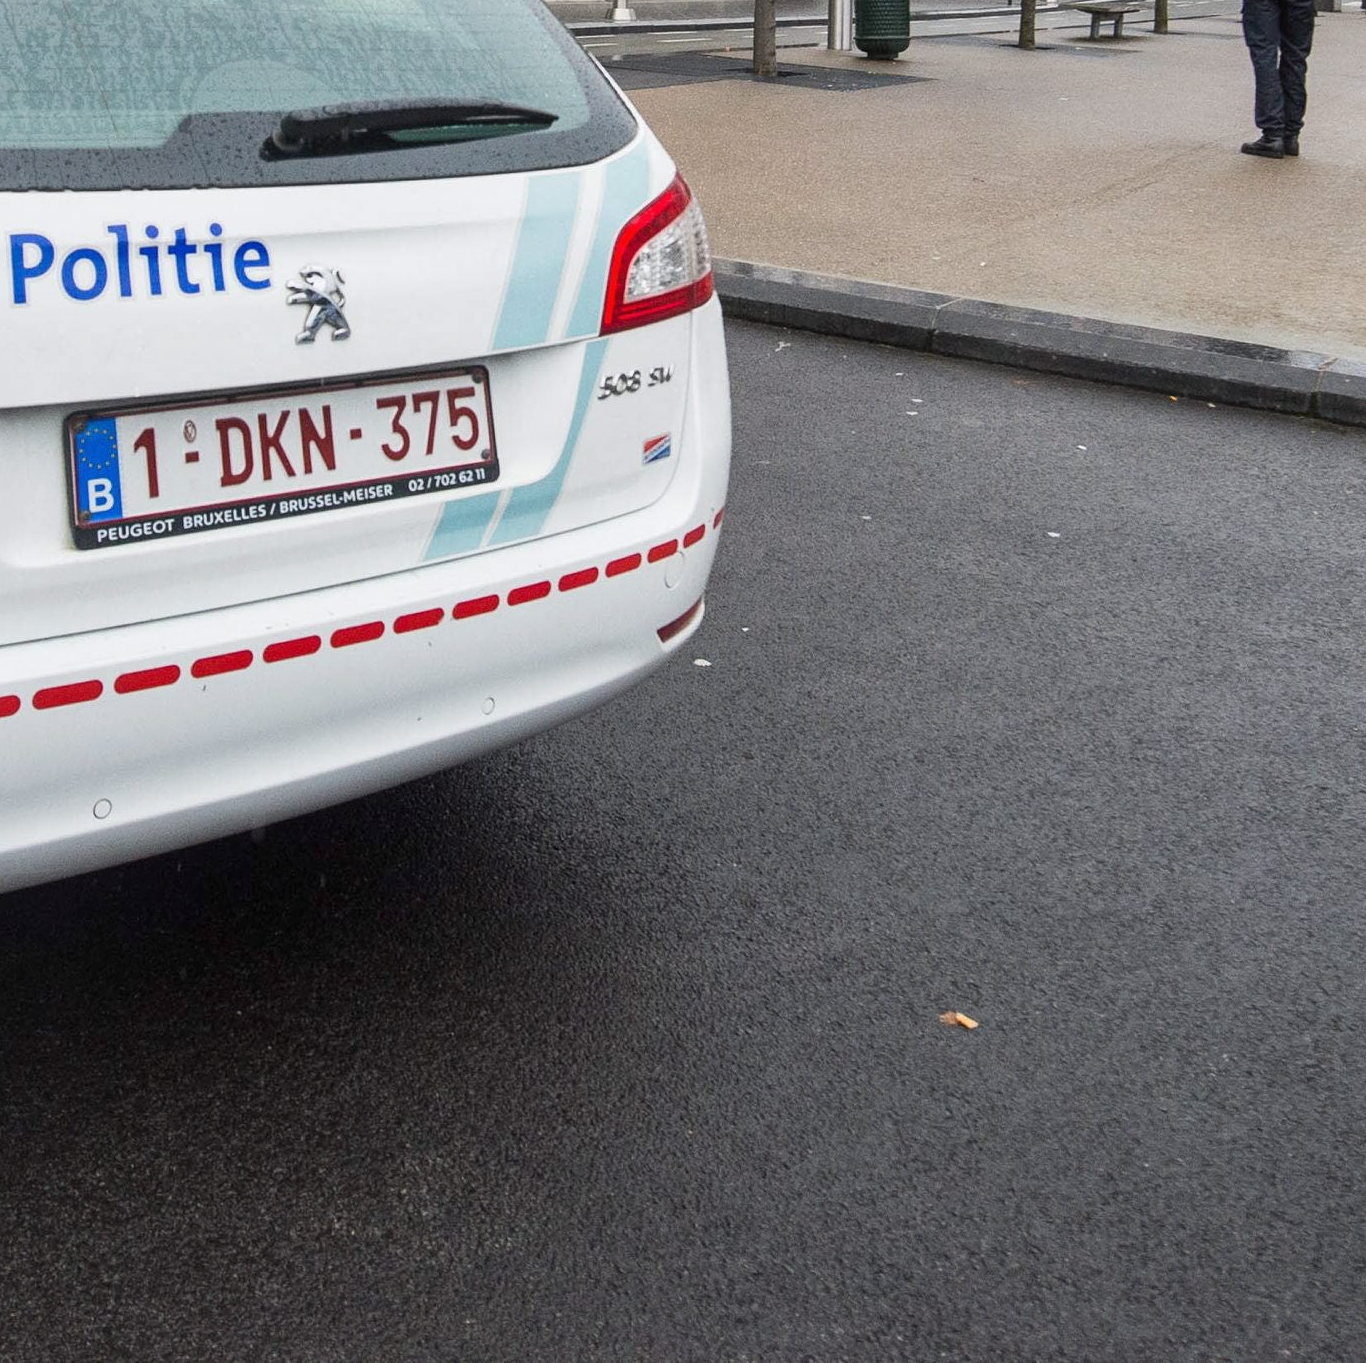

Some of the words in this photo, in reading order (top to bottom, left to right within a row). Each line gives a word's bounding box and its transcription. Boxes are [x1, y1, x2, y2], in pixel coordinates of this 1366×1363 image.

[9, 222, 272, 305] Politie
[598, 370, 641, 400] 508
[87, 477, 114, 514] B
[97, 518, 174, 544] PEUGEOT
[183, 504, 267, 529] BRUXELLES
[280, 484, 393, 515] BRUSSEL-MEISER
[408, 479, 424, 493] 02
[434, 473, 458, 489] 702
[460, 470, 475, 485] 62
[476, 468, 486, 482] 11
